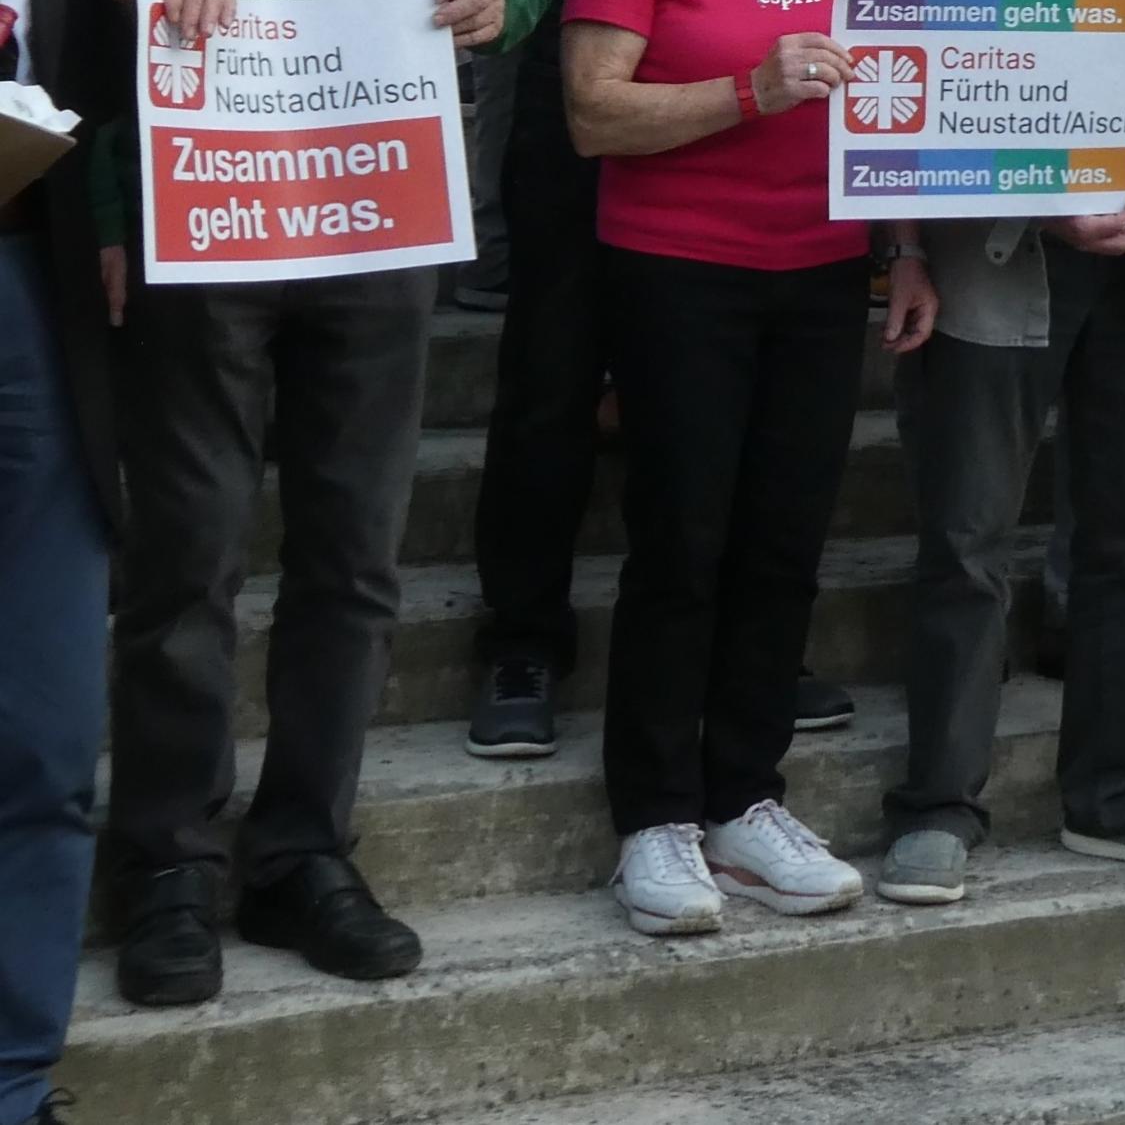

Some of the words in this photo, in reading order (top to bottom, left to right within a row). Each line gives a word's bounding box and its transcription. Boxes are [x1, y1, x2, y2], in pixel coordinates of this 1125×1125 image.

[856, 0, 997, 24] Zusammen
[1004, 2, 1060, 27] geht
[1066, 5, 1123, 24] was.
[216, 48, 273, 77] Fürth
[283, 46, 343, 75] und
[940, 46, 1036, 70] Caritas
[216, 75, 438, 115] Neustadt/Aisch
[939, 78, 1009, 102] Fürth
[1019, 79, 1068, 102] und
[170, 137, 408, 183] Zusammen
[852, 165, 990, 188] Zusammen
[998, 165, 1054, 190] geht
[1060, 165, 1112, 185] was.
[188, 197, 268, 252] geht
[278, 197, 395, 238] was.
